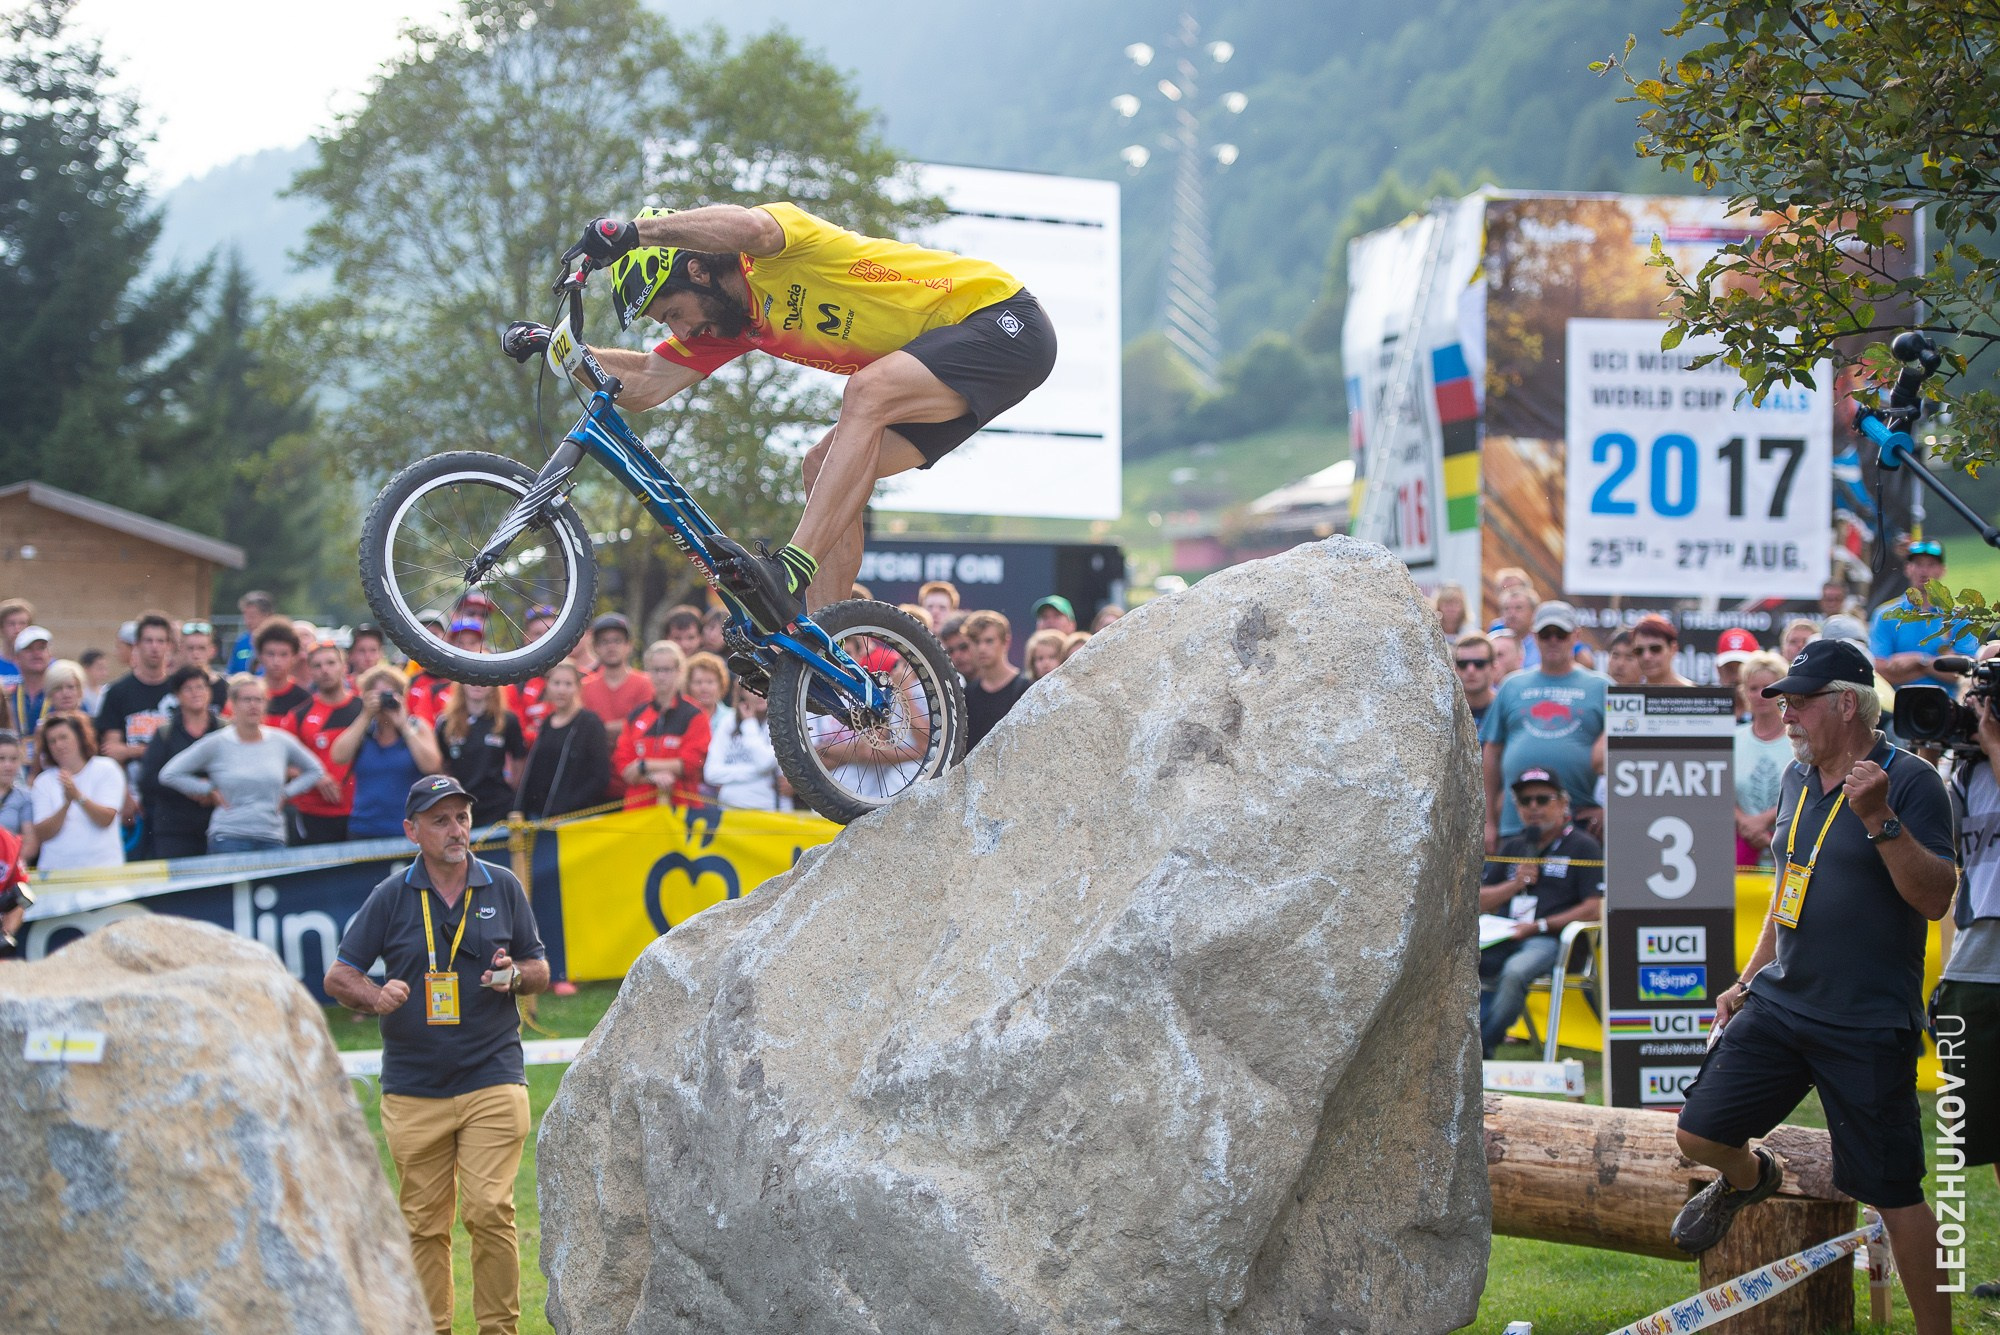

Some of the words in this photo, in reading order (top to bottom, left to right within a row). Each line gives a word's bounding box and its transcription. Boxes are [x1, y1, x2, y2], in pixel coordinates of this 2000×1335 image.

[842, 309, 855, 340] movistar
[1591, 387, 1672, 408] WORLD
[1682, 388, 1726, 411] CUP
[1590, 432, 1806, 519] 2017
[924, 553, 956, 581] IT
[956, 554, 1004, 584] ON
[1613, 699, 1642, 712] UCI
[1614, 760, 1727, 797] START
[1645, 815, 1697, 900] 3
[1656, 935, 1697, 954] UCI
[1653, 1015, 1693, 1033] UCI
[1658, 1075, 1697, 1094] UC
